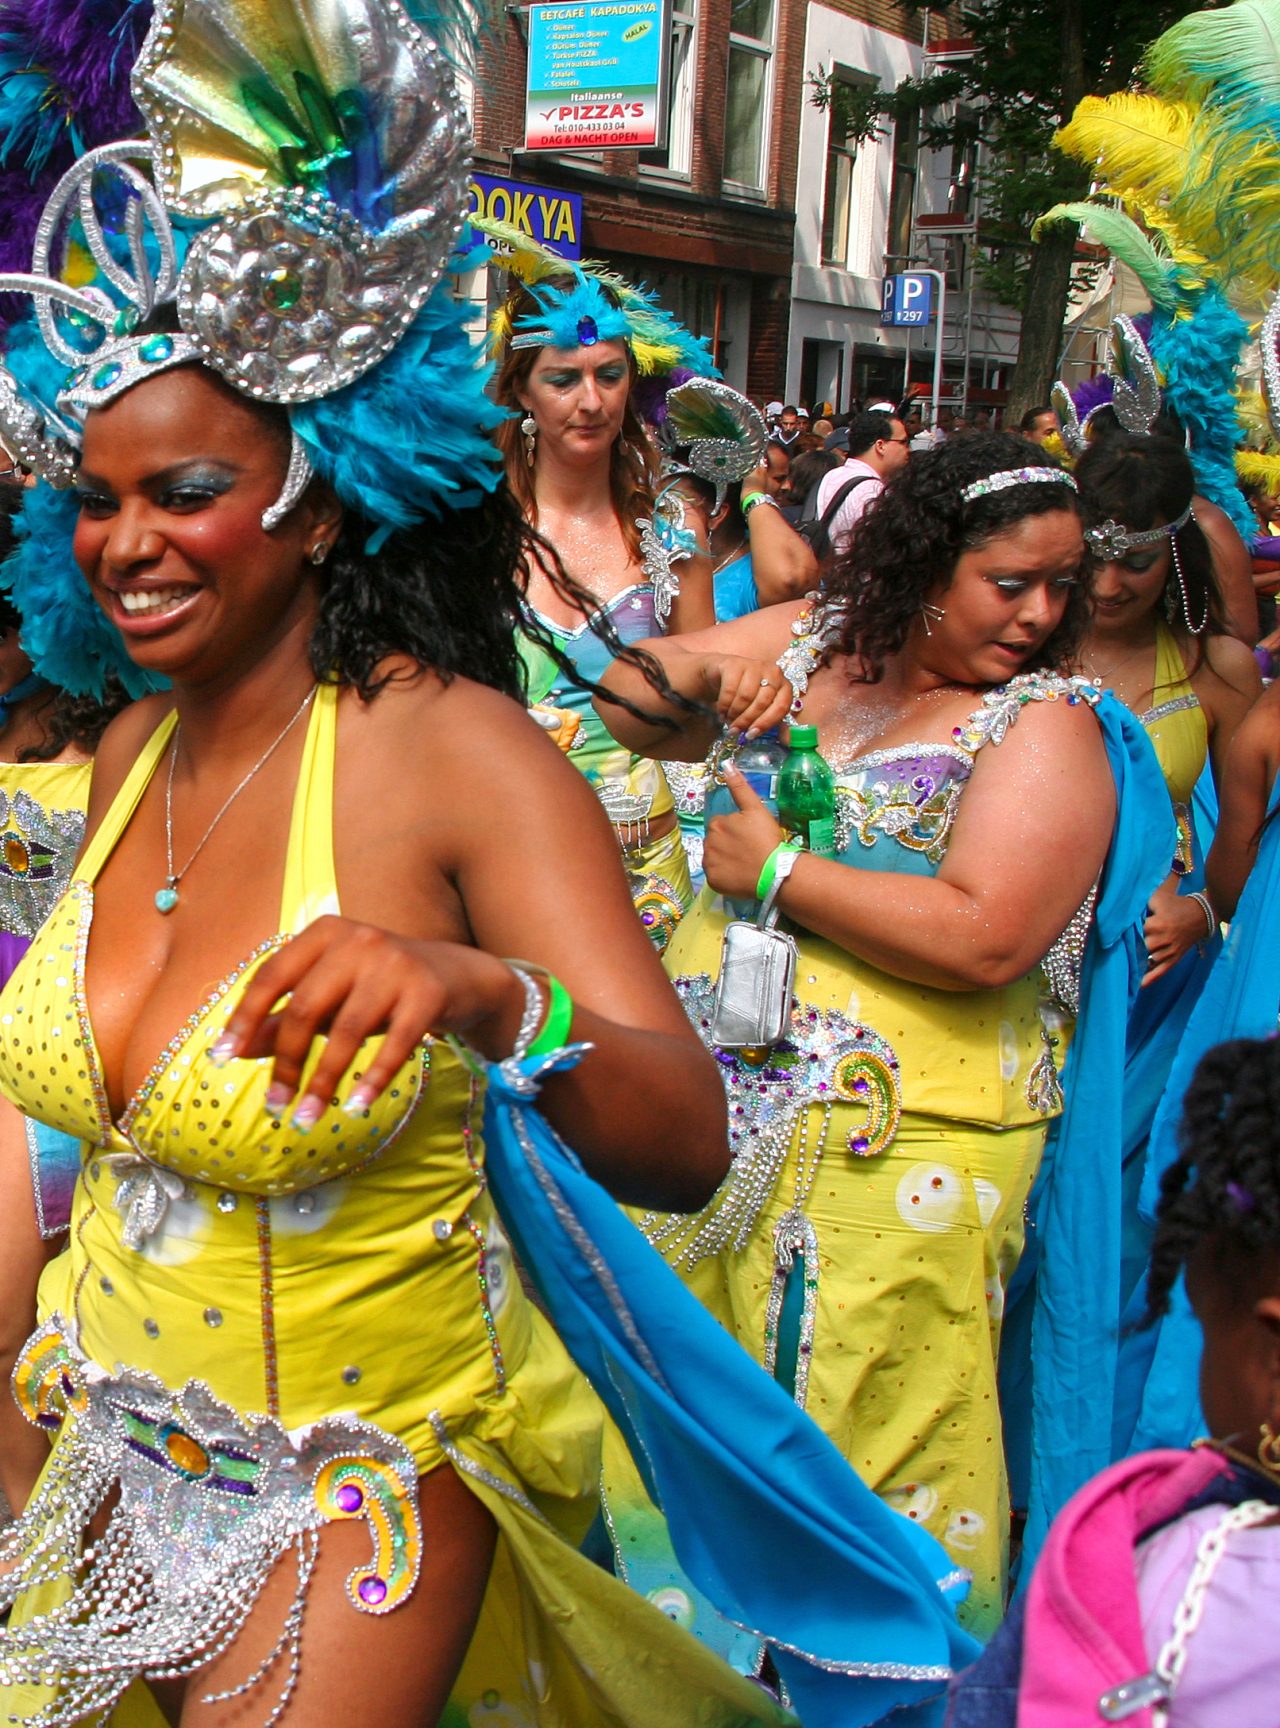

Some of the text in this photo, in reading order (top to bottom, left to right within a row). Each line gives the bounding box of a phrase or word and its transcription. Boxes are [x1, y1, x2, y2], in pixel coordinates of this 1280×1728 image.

[590, 3, 657, 17] KAPADOKYA
[625, 24, 648, 40] HALAL
[571, 92, 623, 102] Italiaanse
[559, 102, 645, 121] PIZZA'S
[603, 122, 613, 131] 03
[615, 121, 625, 130] 04
[541, 132, 639, 145] DAG & NACHT OPEN
[903, 278, 923, 309] P
[903, 311, 923, 322] 297
